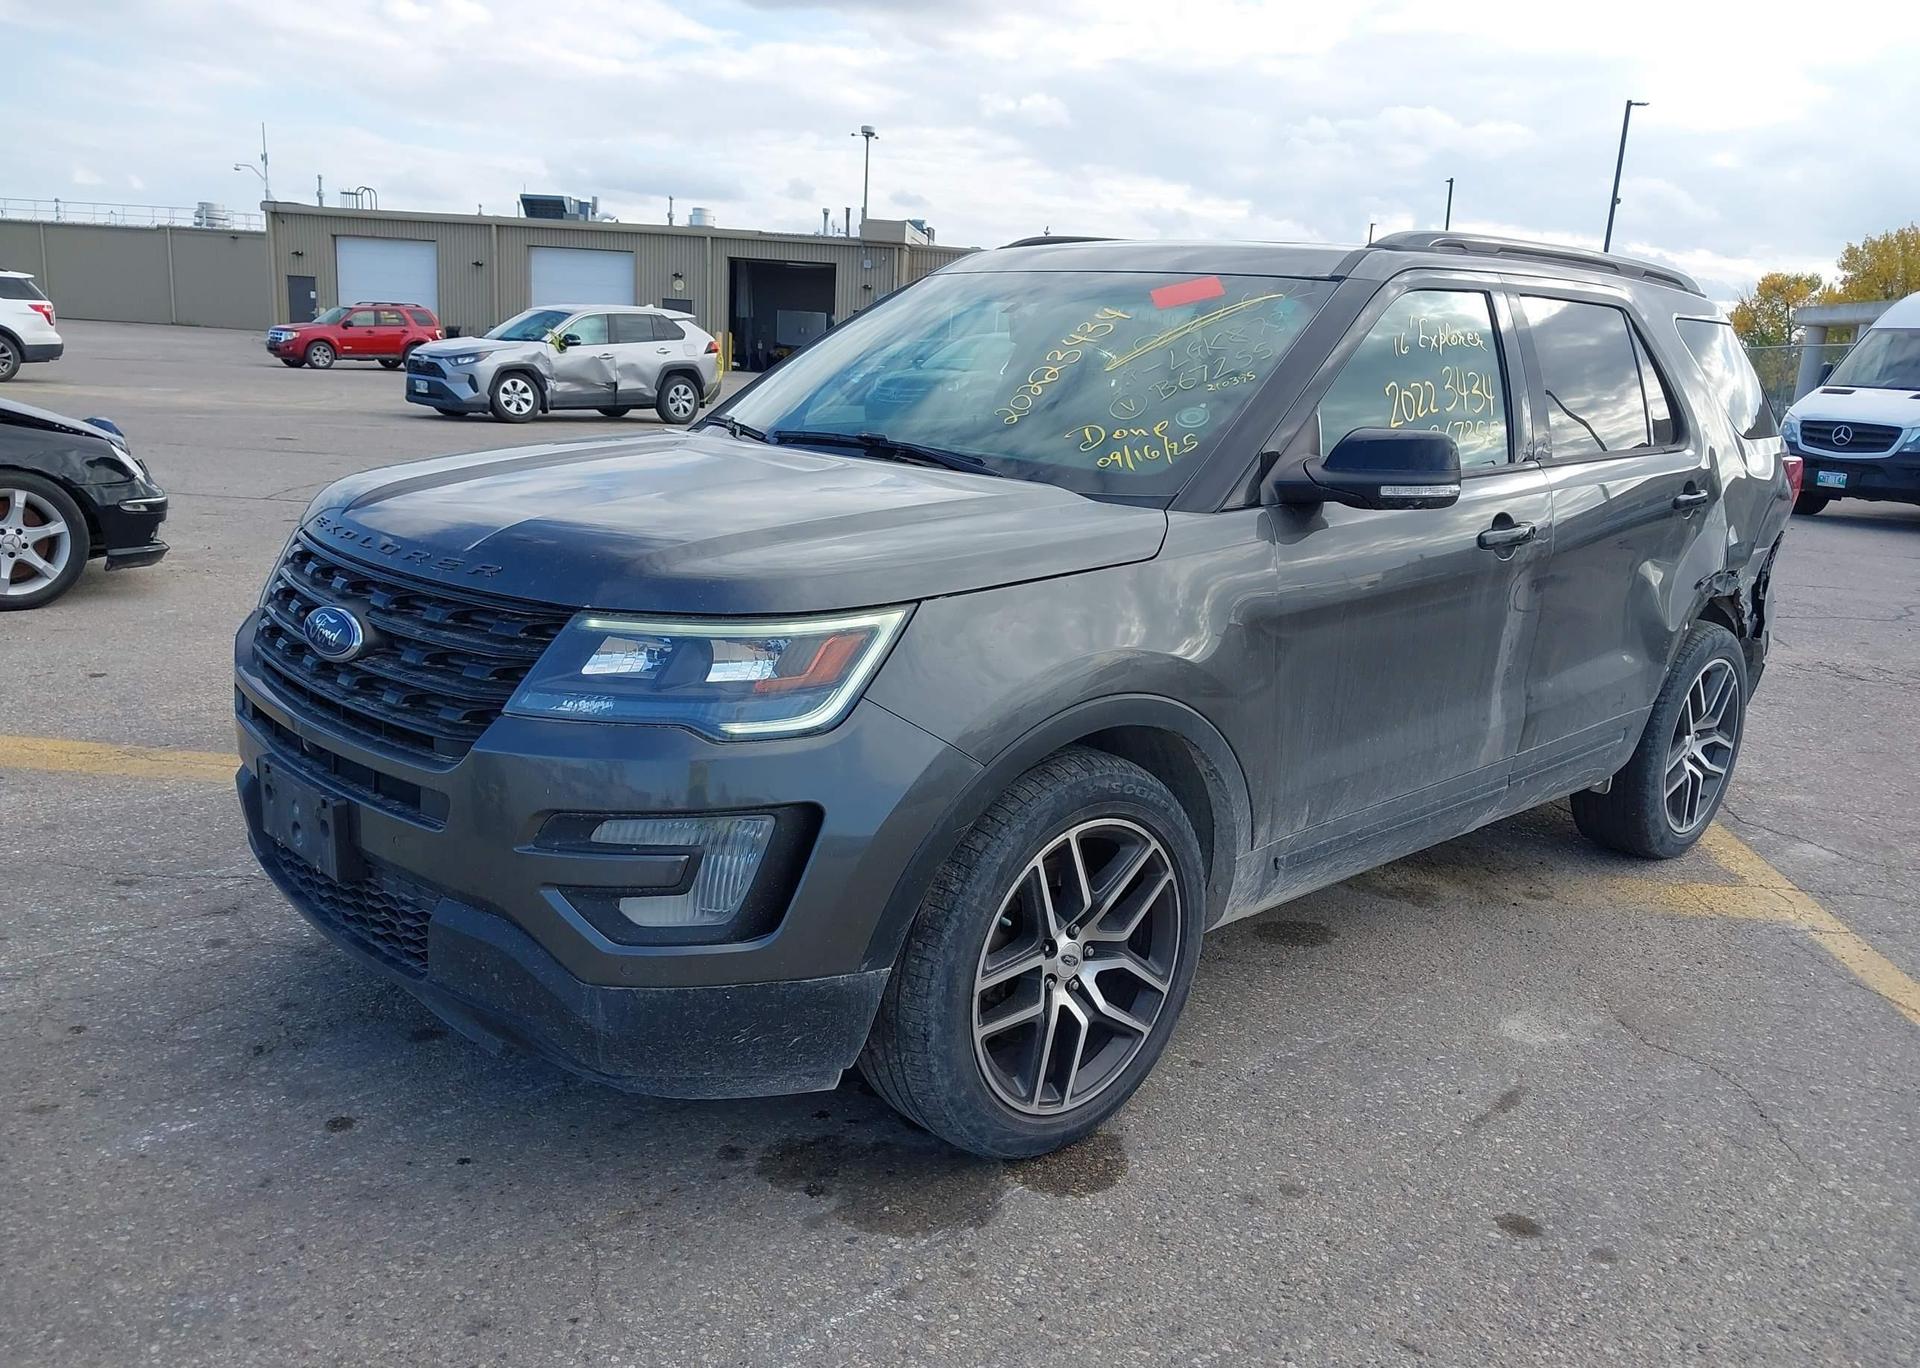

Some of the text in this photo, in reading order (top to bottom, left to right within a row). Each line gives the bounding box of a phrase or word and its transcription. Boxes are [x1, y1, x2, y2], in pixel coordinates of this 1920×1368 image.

[1063, 419, 1169, 453] Done
[315, 516, 505, 578] EXPLORER
[315, 612, 343, 642] Ford
